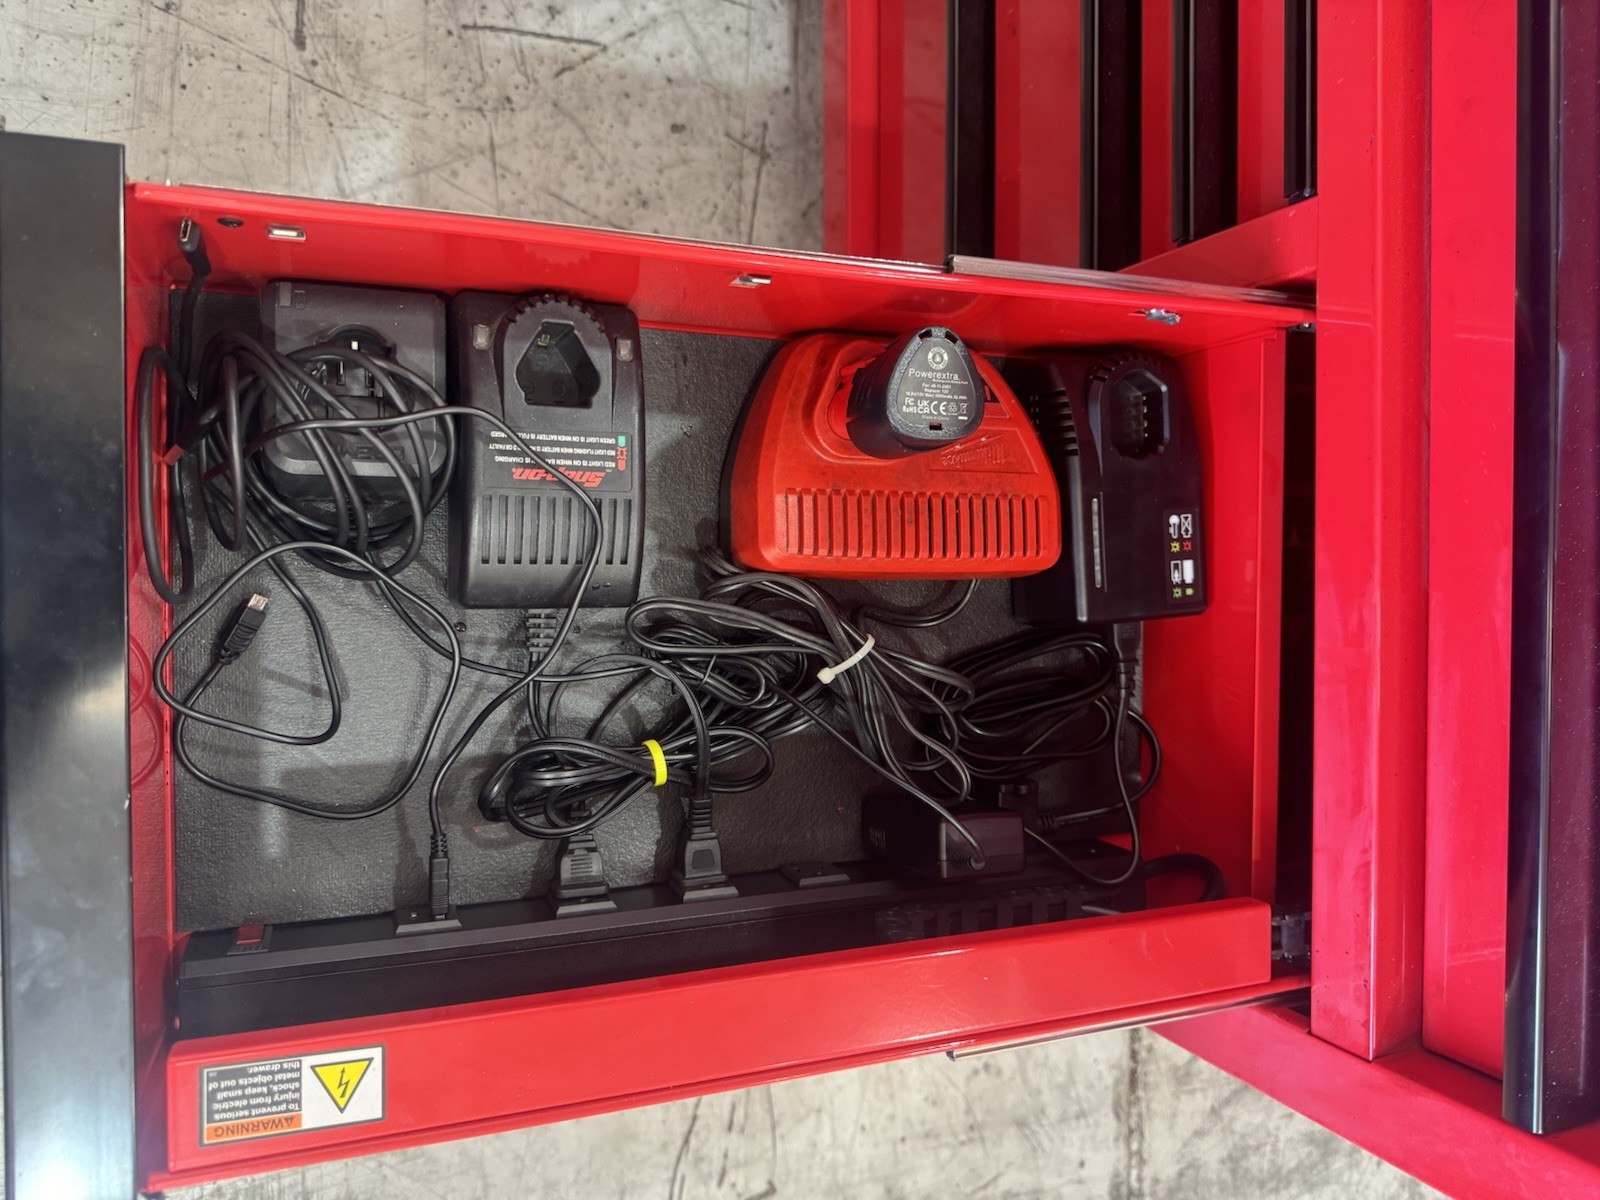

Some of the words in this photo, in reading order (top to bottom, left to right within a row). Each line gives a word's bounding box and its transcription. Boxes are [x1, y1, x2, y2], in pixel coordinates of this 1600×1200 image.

[908, 368, 958, 380] Powerextra
[247, 1063, 281, 1074] drawer.
[283, 1060, 300, 1071] this
[238, 1074, 273, 1086] objects
[274, 1071, 300, 1081] metal
[208, 1082, 218, 1091] of
[220, 1079, 236, 1088] out
[269, 1081, 300, 1092] shock,
[217, 1090, 243, 1100] small
[245, 1085, 268, 1096] keep
[249, 1095, 272, 1106] from
[273, 1091, 300, 1102] injury
[212, 1099, 247, 1110] electric
[251, 1102, 287, 1116] prevent
[287, 1103, 300, 1111] To
[214, 1109, 249, 1121] serious
[214, 1118, 284, 1137] WARNING
